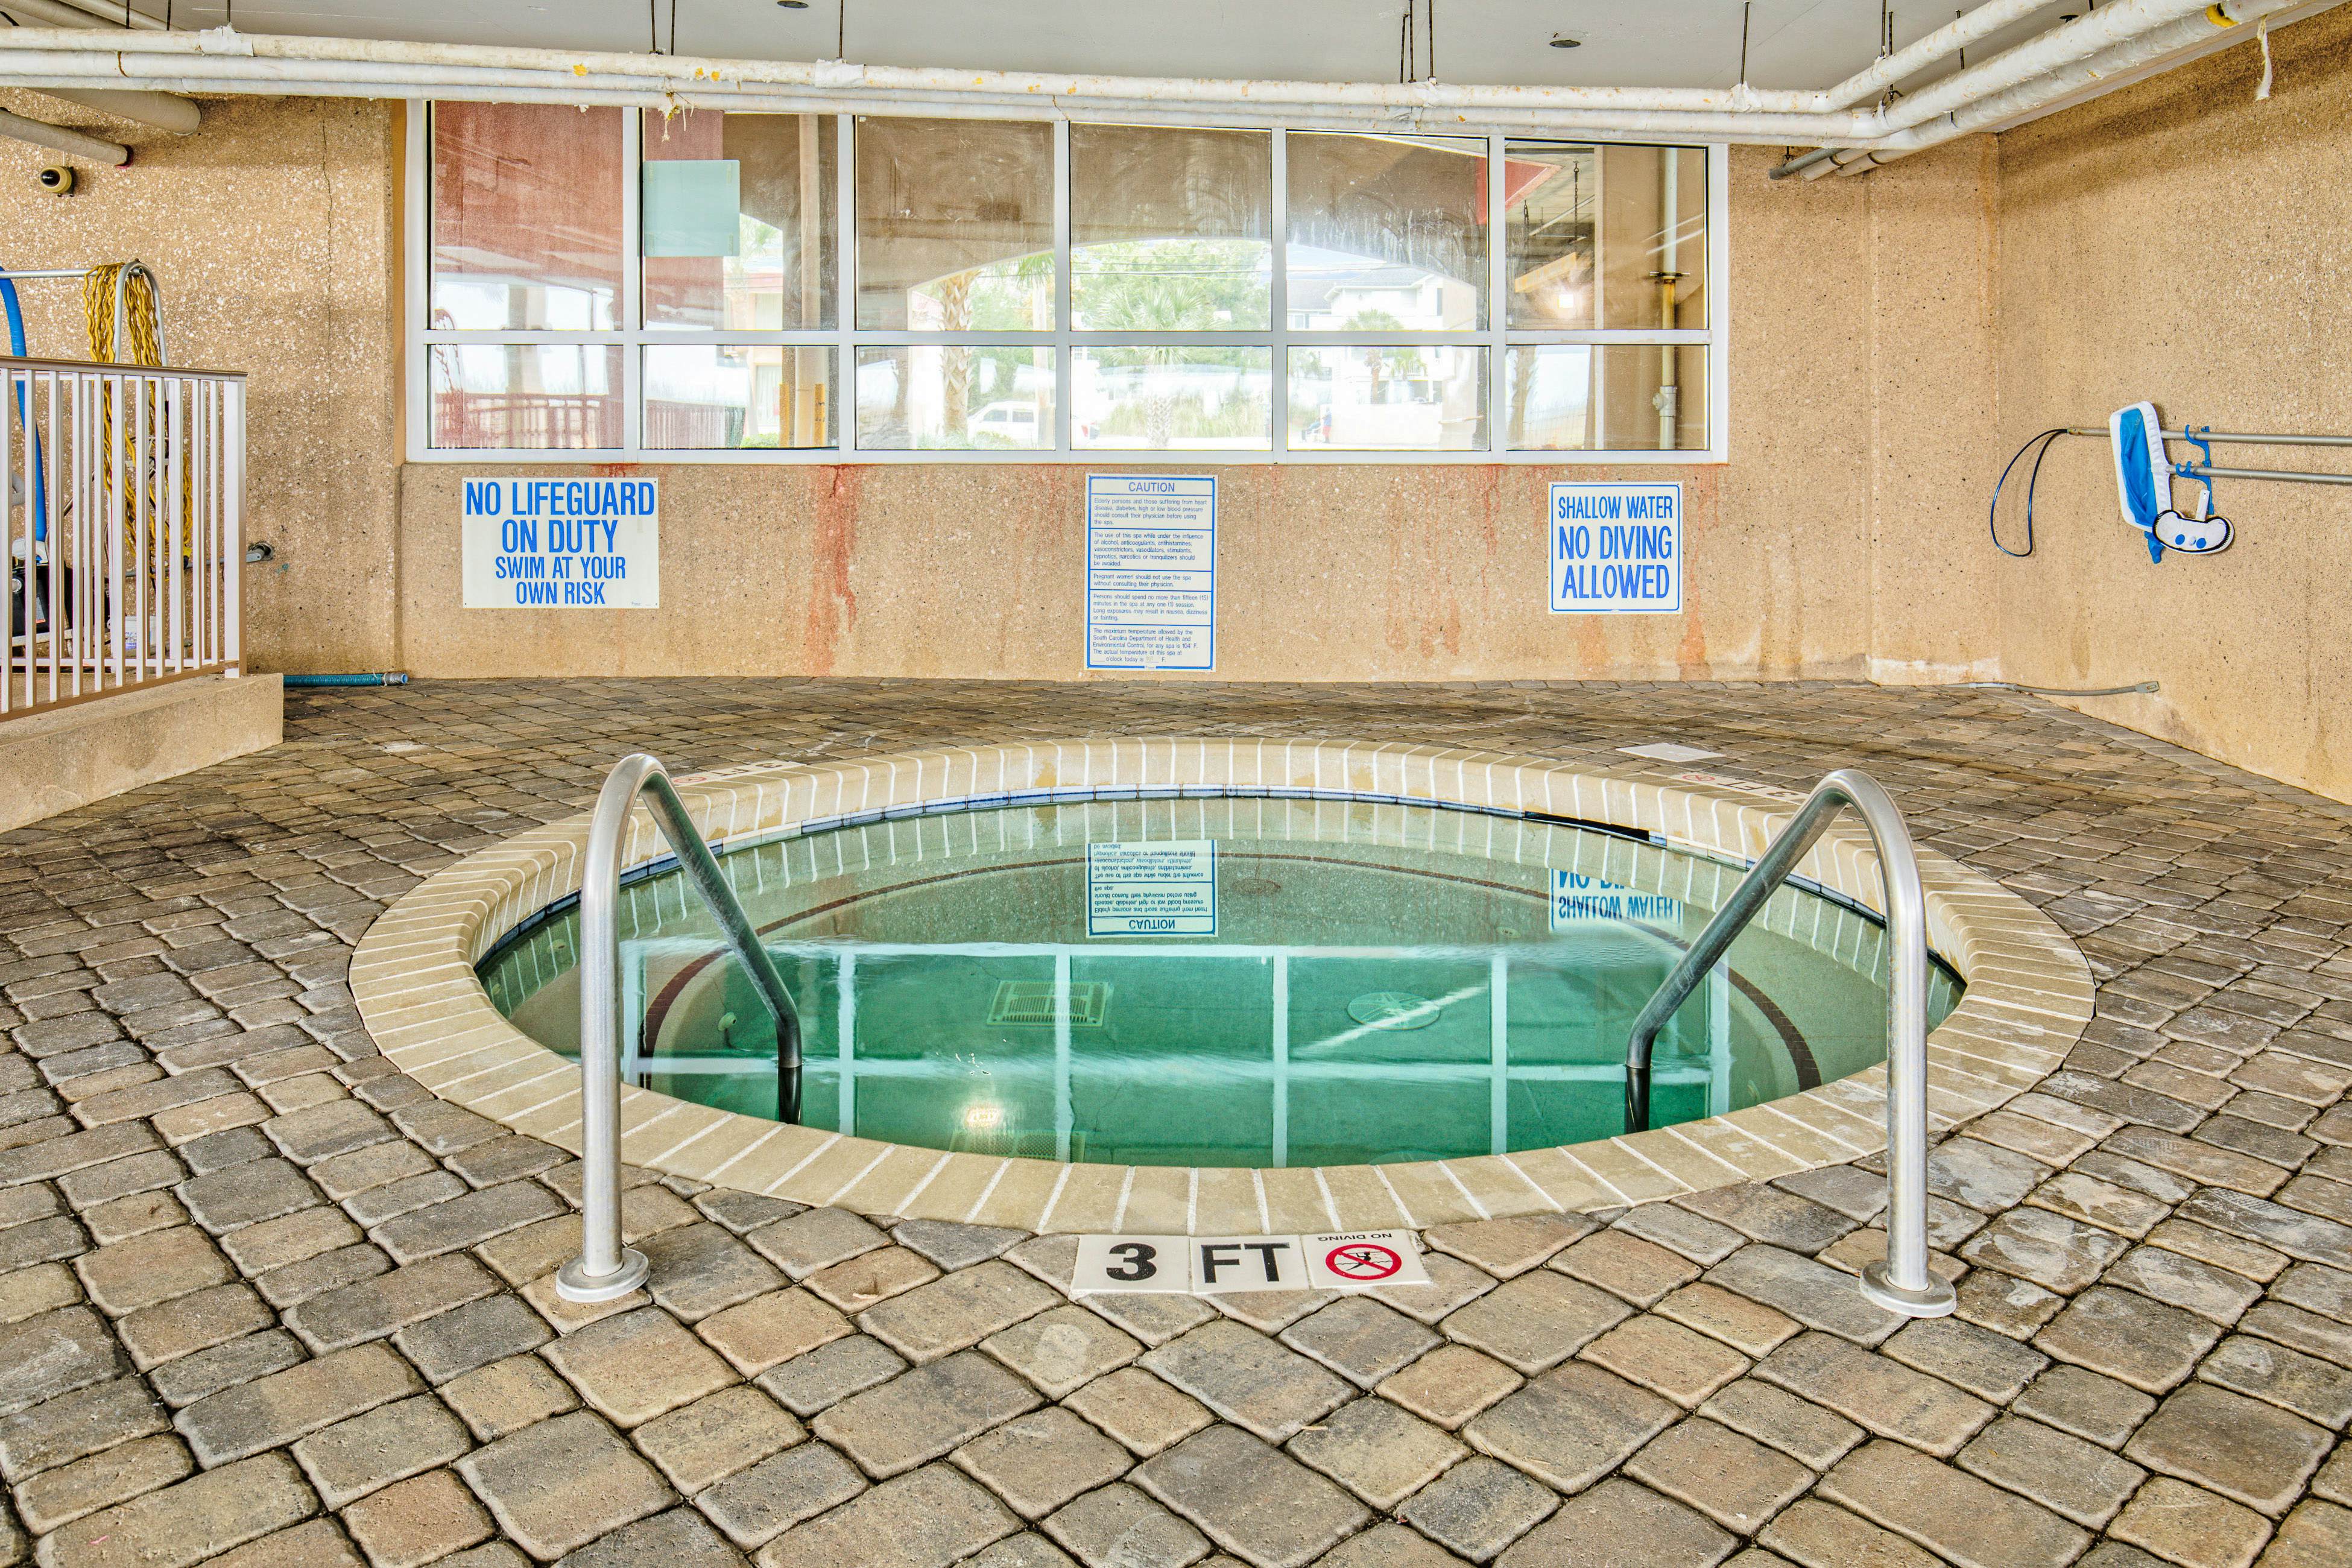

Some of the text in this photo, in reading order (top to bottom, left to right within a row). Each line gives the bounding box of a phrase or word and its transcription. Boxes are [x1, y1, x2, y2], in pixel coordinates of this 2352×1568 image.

[466, 482, 654, 515] NO LIFEGUARD
[1128, 482, 1174, 492] CAUTION
[1559, 496, 1672, 519] SHALLOW WATER
[502, 519, 618, 553] ON DUTY
[1559, 526, 1672, 559] NO DIVING
[495, 556, 625, 579] SWIM AT YOUR
[1561, 564, 1669, 598] ALLOWED
[516, 581, 605, 604] OWN RISK
[1106, 1242, 1290, 1283] 3 FT
